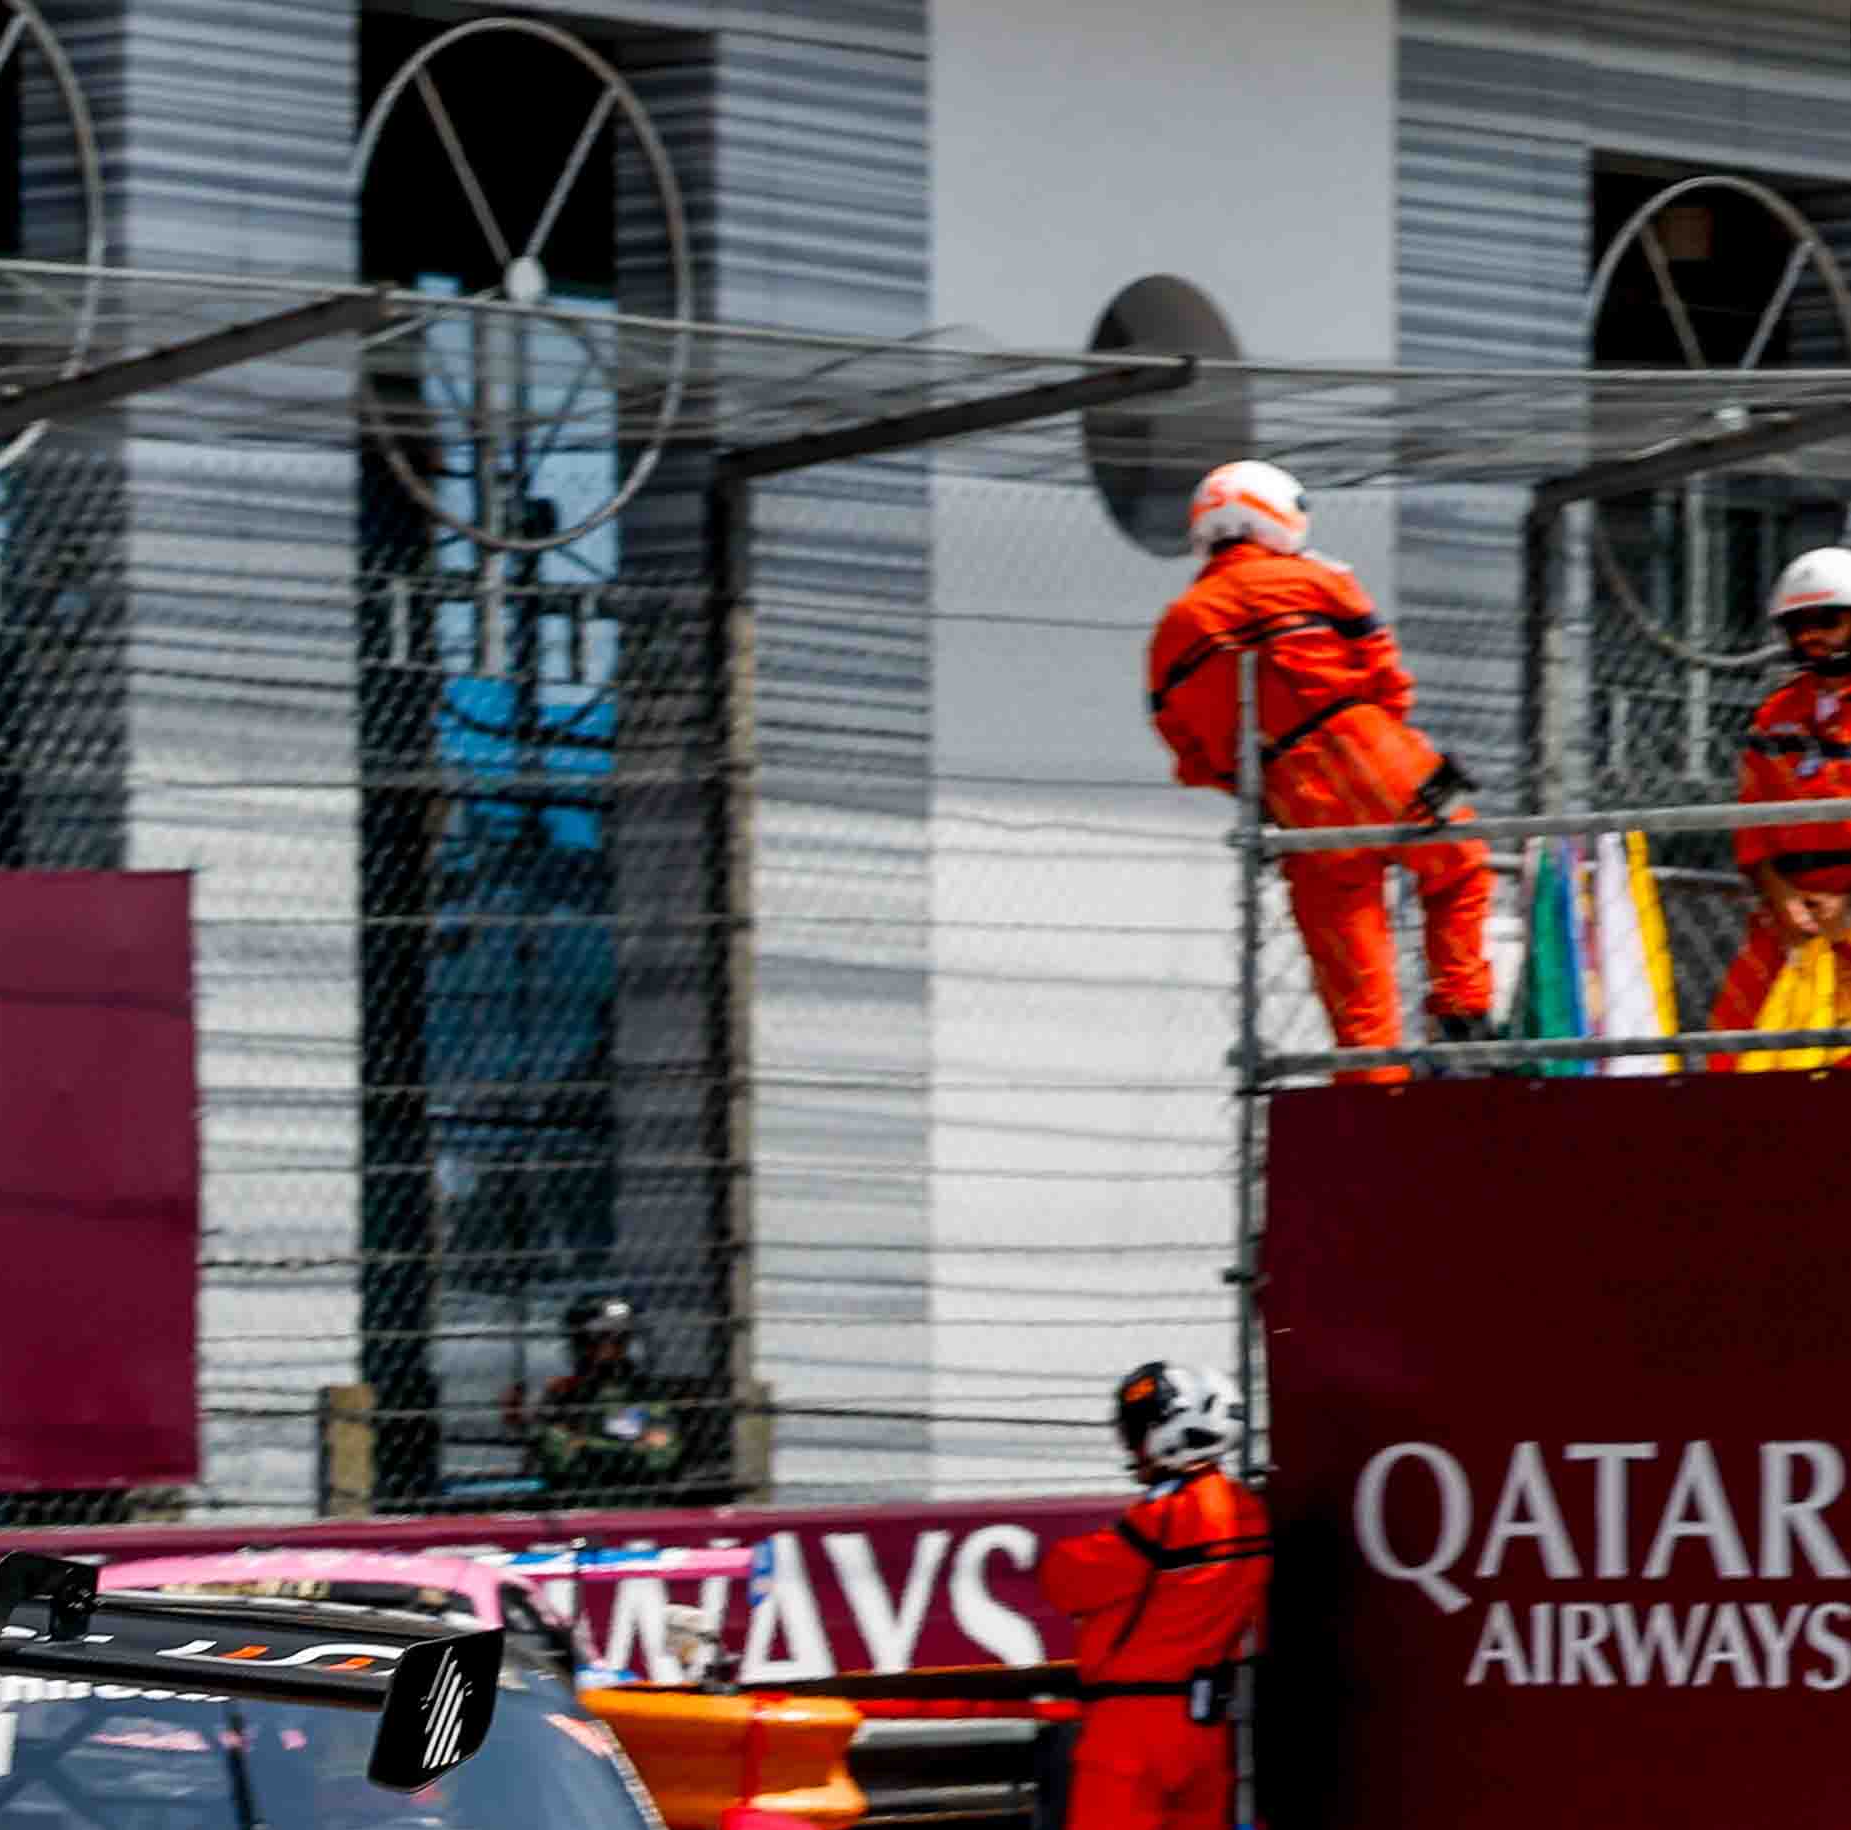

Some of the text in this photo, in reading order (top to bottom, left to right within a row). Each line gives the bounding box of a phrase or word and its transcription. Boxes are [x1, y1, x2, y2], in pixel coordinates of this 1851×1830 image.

[413, 1524, 1043, 1686] WAYS
[1354, 1440, 1851, 1614] QATAR
[1465, 1602, 1851, 1689] AIRWAYS
